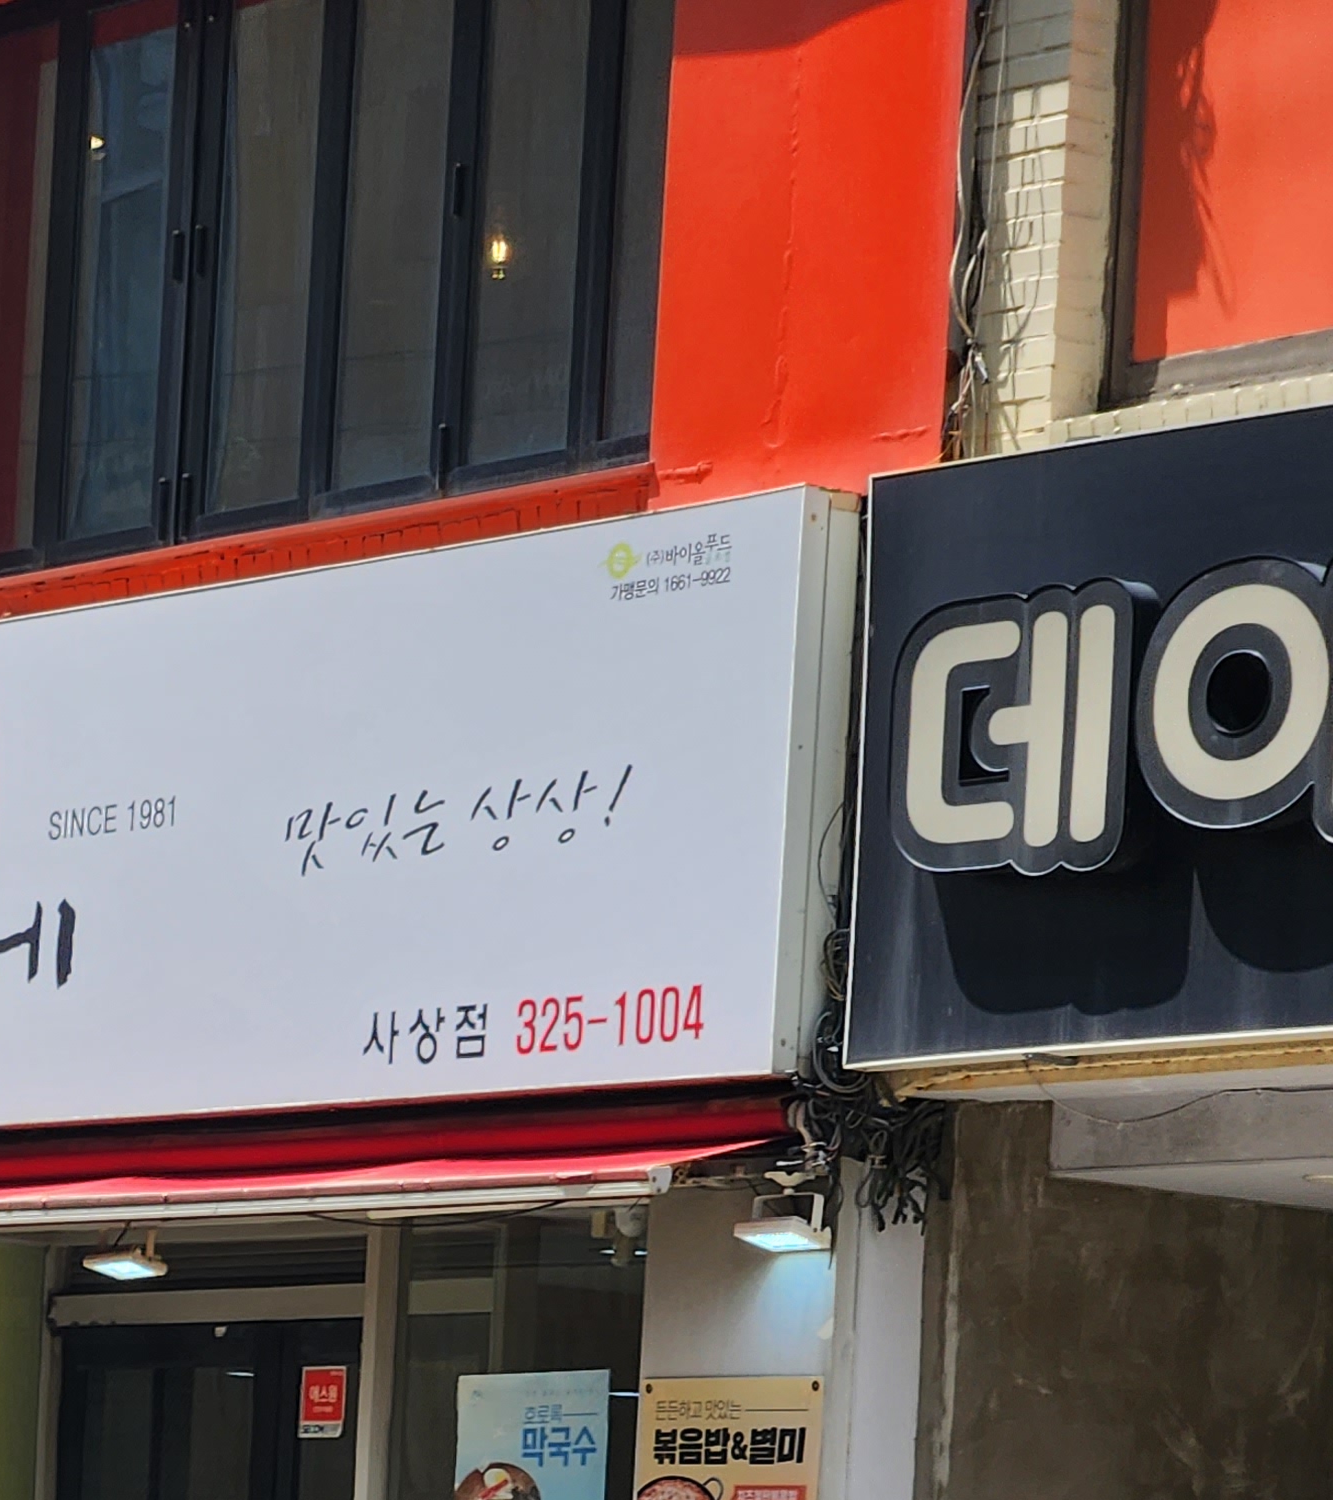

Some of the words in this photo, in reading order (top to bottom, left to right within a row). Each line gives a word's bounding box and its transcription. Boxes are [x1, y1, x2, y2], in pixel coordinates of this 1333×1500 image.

[610, 577, 660, 601] 가맹문의
[664, 567, 731, 593] 1661-9922
[47, 802, 119, 842] SINCE
[126, 796, 177, 831] 1981
[284, 789, 445, 877] 맛있는
[470, 763, 633, 853] 상상!
[362, 1003, 488, 1065] 사상점
[515, 985, 704, 1056] 325-1004
[655, 1400, 702, 1421] 든든하고
[705, 1399, 742, 1421] 맛있는
[520, 1425, 598, 1468] 막국수
[653, 1426, 807, 1465] 볶음밥&별미
